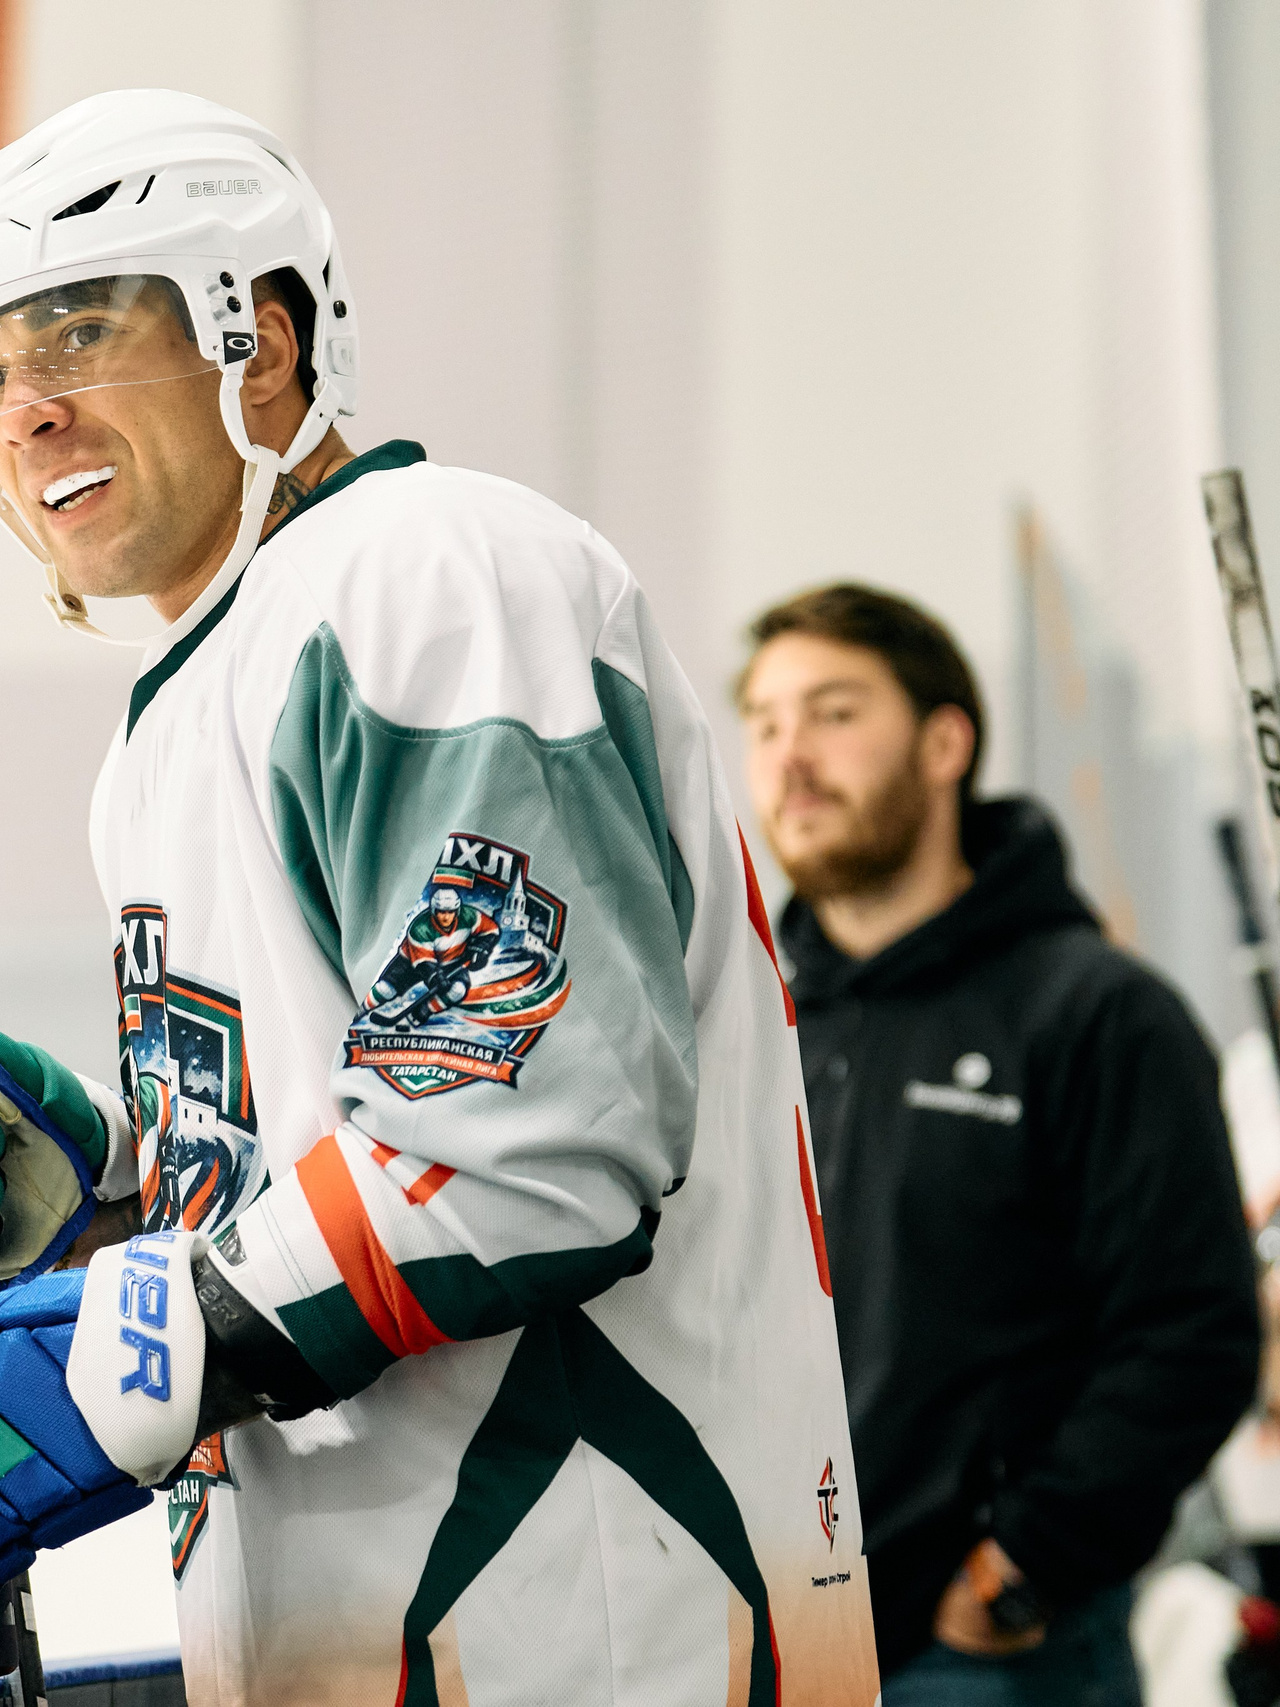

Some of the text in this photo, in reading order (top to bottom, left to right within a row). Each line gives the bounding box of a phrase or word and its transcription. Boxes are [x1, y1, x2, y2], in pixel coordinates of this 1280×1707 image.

[186, 179, 263, 198] BAUER
[121, 918, 164, 988] ХЛ
[370, 1036, 494, 1062] РЕСПУБЛИКАНСКАЯ
[361, 1052, 425, 1062] ЛЮБИТЕЛЬСКАЯ
[475, 1062, 498, 1077] ЛИГА
[390, 1065, 458, 1082] ТАТАРСТАН
